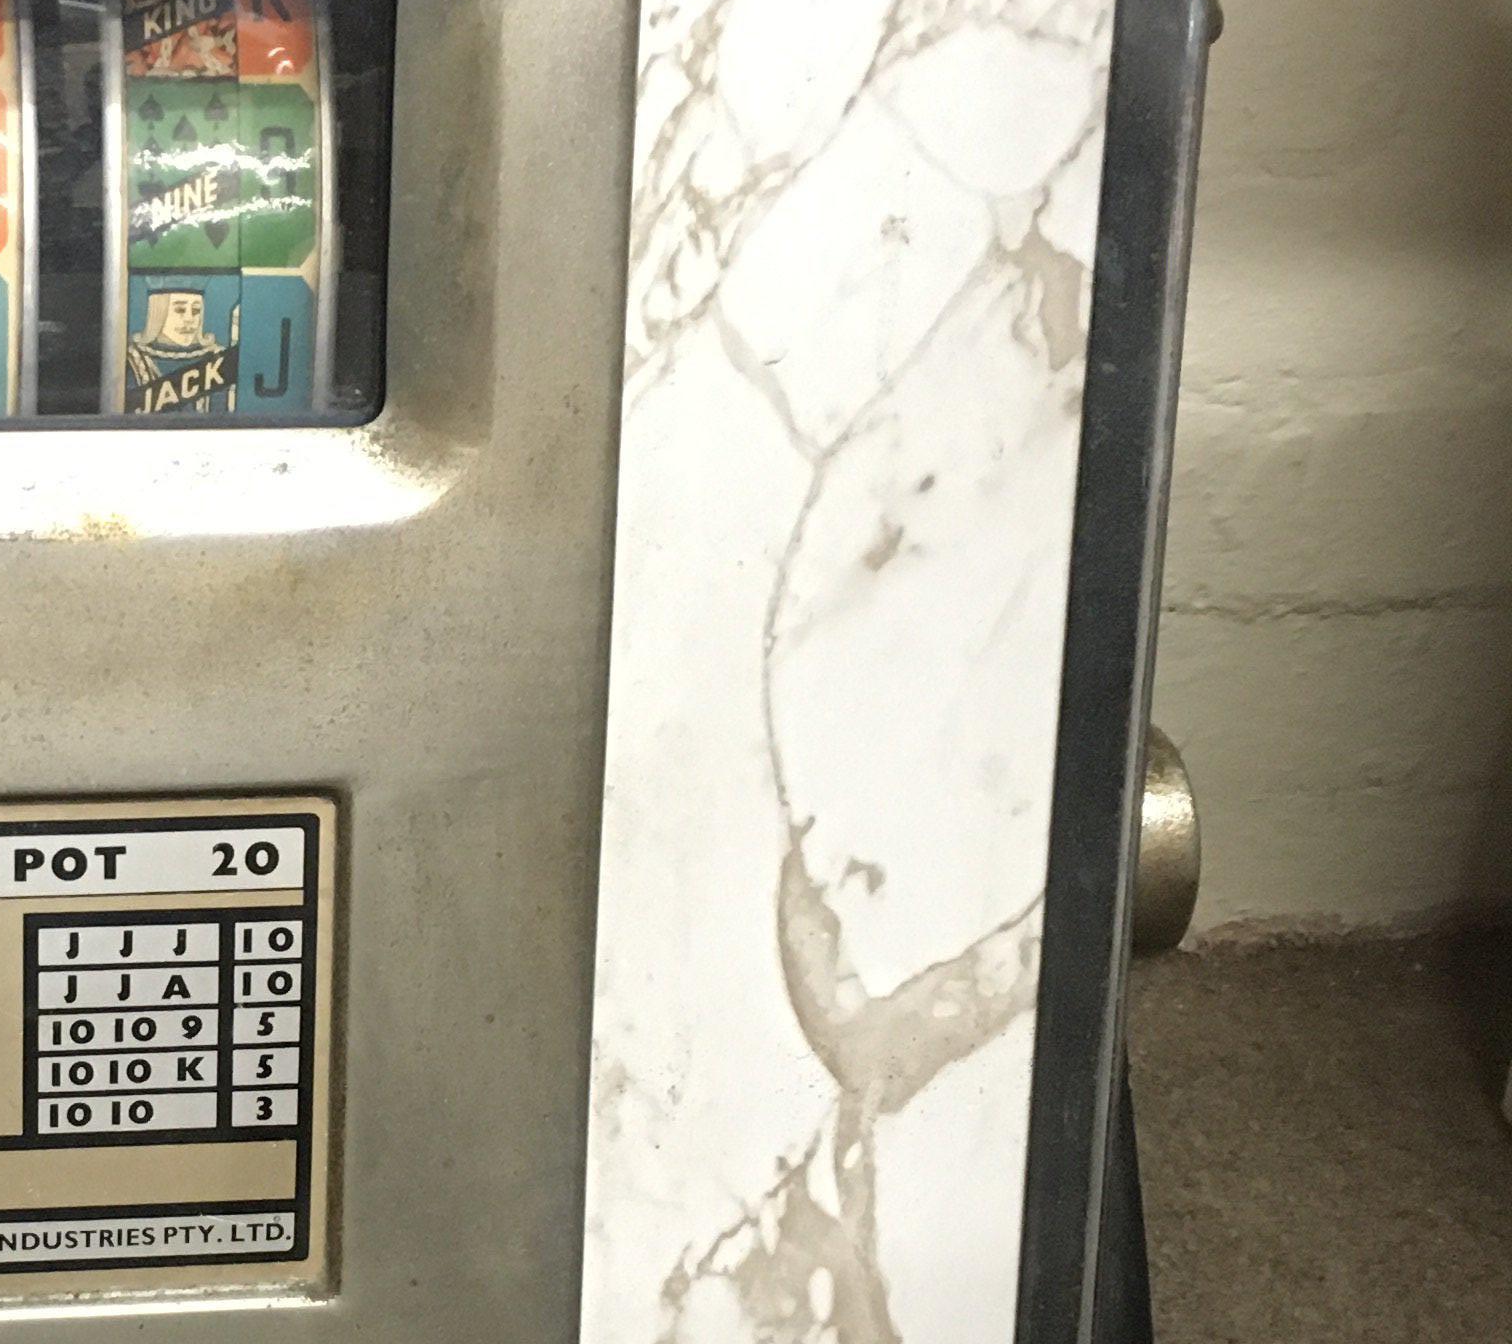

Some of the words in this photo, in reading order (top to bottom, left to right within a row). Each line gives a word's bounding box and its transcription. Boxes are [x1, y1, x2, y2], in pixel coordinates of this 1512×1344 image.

[151, 166, 219, 231] NINE
[135, 356, 224, 414] JACK
[254, 316, 291, 398] J
[15, 846, 126, 881] POT
[212, 842, 279, 876] 20
[243, 927, 293, 953] 10
[243, 971, 292, 996] 10
[257, 1012, 275, 1036] 5
[256, 1055, 273, 1078] 5
[257, 1096, 272, 1120] 3
[164, 1225, 222, 1244] PTY.
